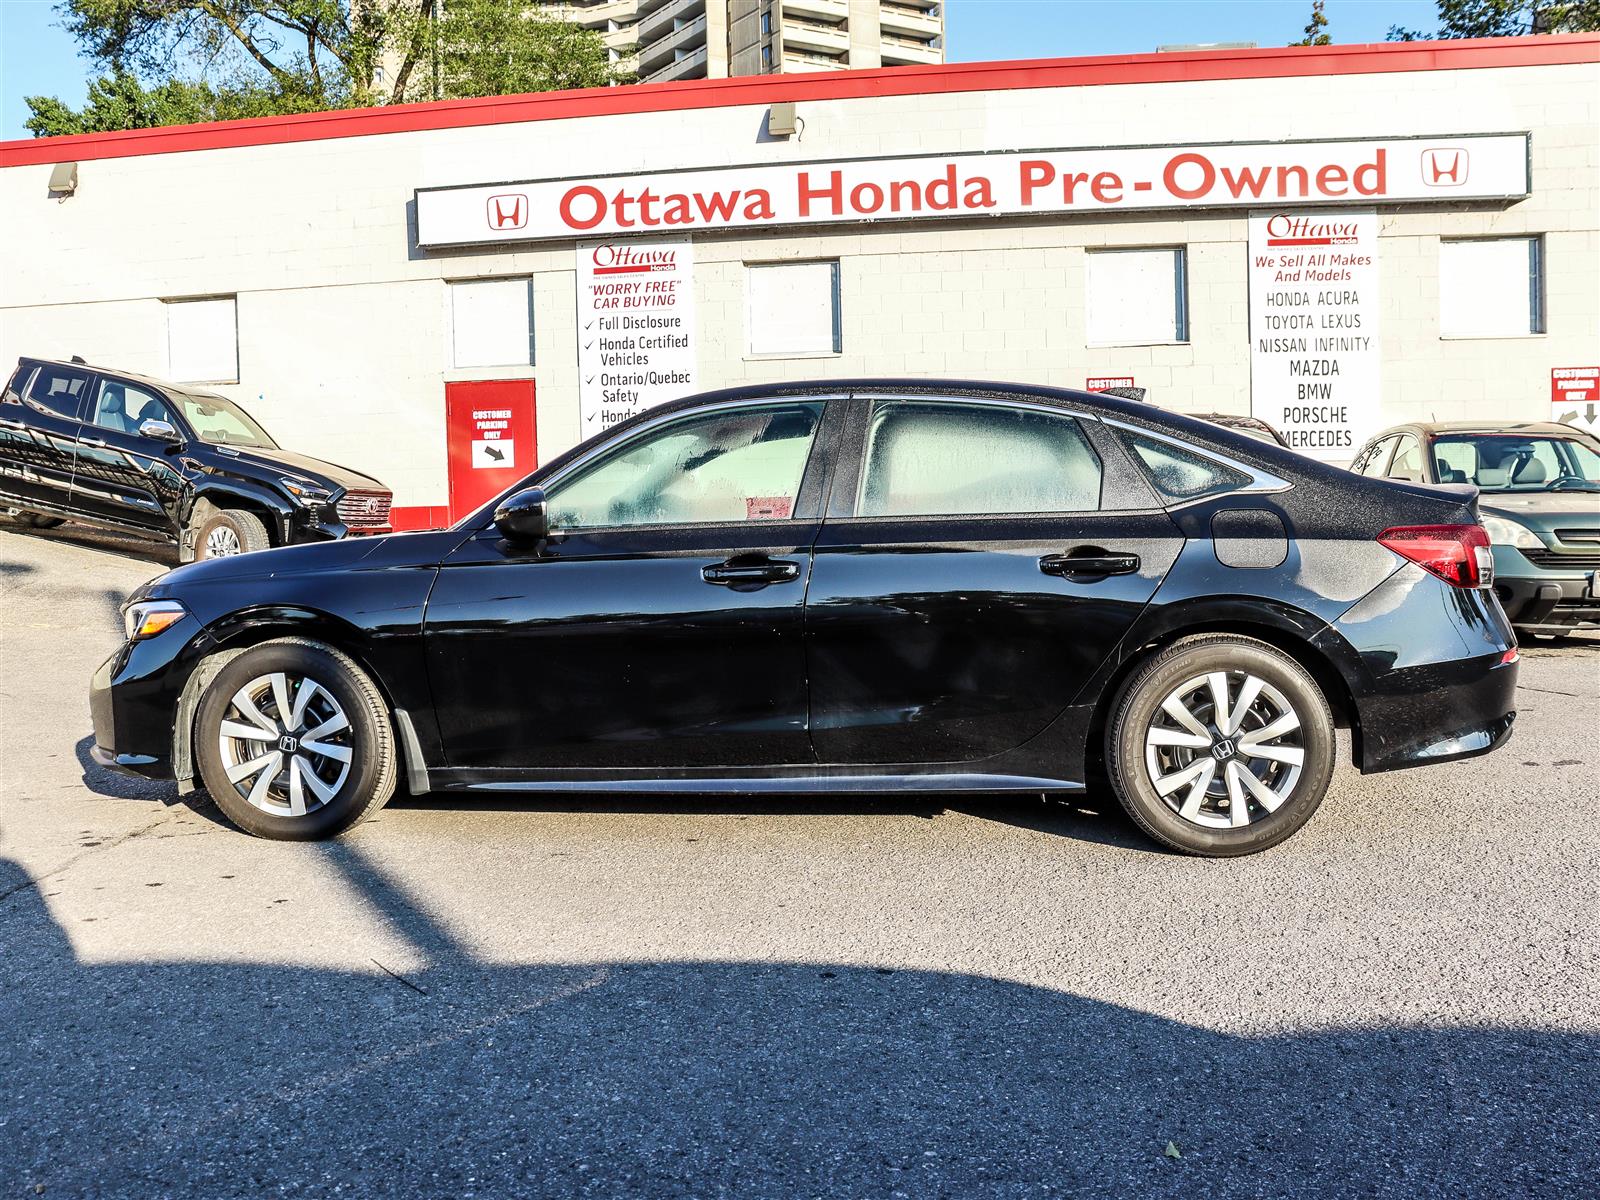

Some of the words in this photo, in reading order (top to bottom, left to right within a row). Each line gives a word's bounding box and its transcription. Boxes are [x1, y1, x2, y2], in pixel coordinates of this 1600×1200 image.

[559, 184, 776, 230] Ottawa
[797, 164, 996, 218] Honda
[1019, 148, 1387, 206] Pre-Owned
[1266, 214, 1358, 238] Ottawa
[592, 243, 676, 266] Ottawa
[1256, 256, 1274, 268] We
[1280, 254, 1304, 268] Sell
[1308, 254, 1326, 266] All
[1330, 253, 1371, 266] Makes
[650, 264, 676, 272] Honda
[1275, 270, 1300, 282] And
[1305, 268, 1352, 282] Models
[588, 282, 641, 296] "WORRY
[646, 280, 682, 292] FREE"
[594, 297, 619, 310] CAR
[624, 294, 676, 308] BUYING
[1266, 292, 1310, 306] HONDA
[1318, 290, 1359, 306] ACURA
[600, 316, 618, 330] Full
[623, 315, 680, 330] Disclosure
[1264, 315, 1314, 330] TOYOTA
[1322, 314, 1361, 328] LEXUS
[600, 336, 635, 350] Honda
[639, 334, 688, 348] Certified
[1260, 338, 1306, 352] NISSAN
[1315, 336, 1370, 352] INFINITY
[600, 352, 648, 366] Vehicles
[1290, 359, 1340, 376] MAZDA
[601, 370, 690, 386] Ontario/Quebec
[1088, 378, 1132, 388] CUSTOMER
[602, 388, 638, 405] Safety
[1298, 383, 1332, 400] BMW
[472, 410, 512, 420] CUSTOMER
[1284, 406, 1348, 424] PORSCHE
[476, 420, 508, 430] PARKING
[484, 430, 501, 440] ONLY
[1279, 430, 1352, 447] MERCEDES
